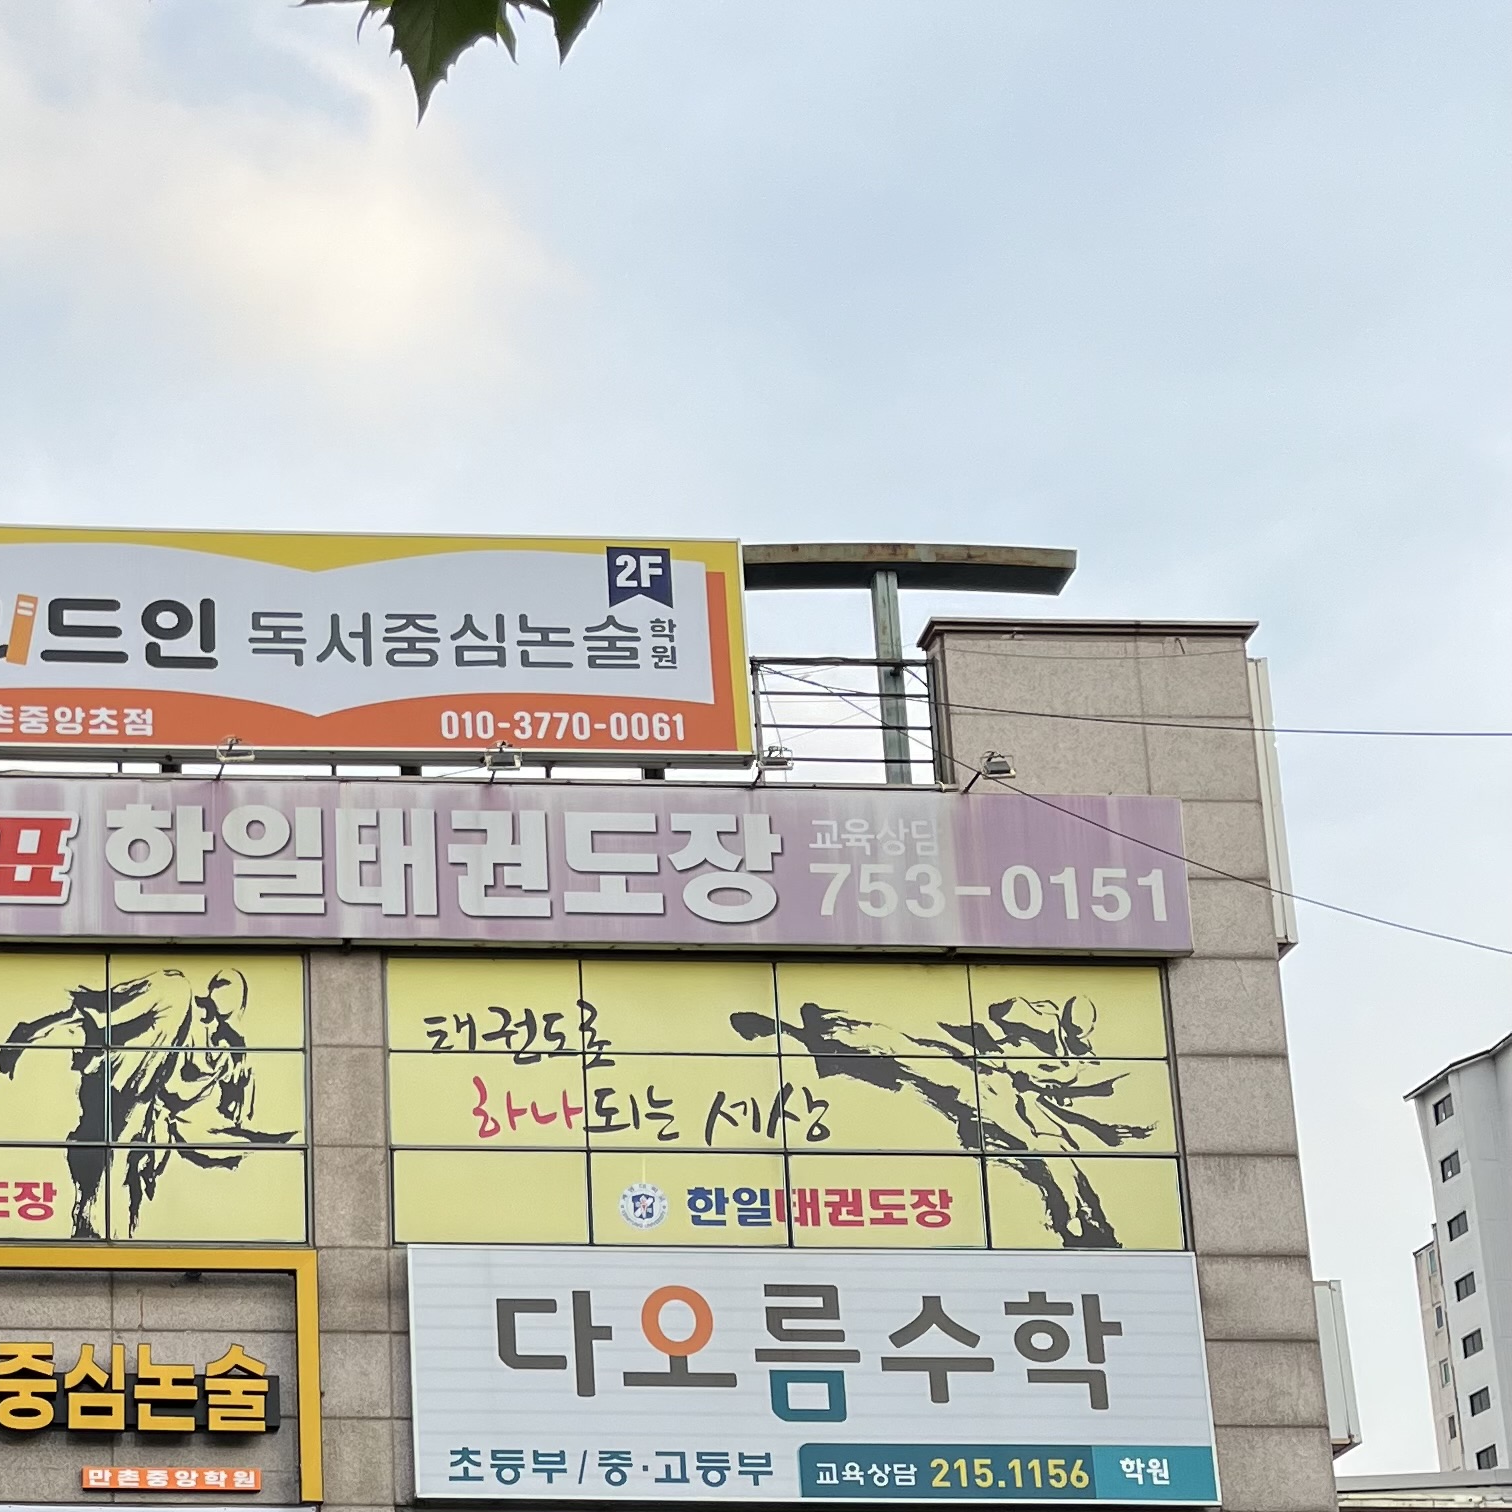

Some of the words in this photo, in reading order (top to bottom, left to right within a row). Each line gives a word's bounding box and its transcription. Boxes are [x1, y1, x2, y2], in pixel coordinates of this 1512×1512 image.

[615, 555, 663, 588] 2F
[248, 612, 641, 669] 독서중심논술
[441, 710, 685, 741] 010-3770-0061
[808, 818, 939, 857] 교육상담
[104, 804, 782, 923] 한일태권도장
[809, 863, 1169, 922] 753-0151
[424, 1000, 616, 1068] 태권도로
[472, 1077, 679, 1138] 하나되는
[705, 1084, 831, 1145] 세상
[687, 1187, 953, 1228] 한일태권도장
[496, 1285, 1123, 1422] 다오름수학
[88, 1469, 257, 1488] 만촌중앙학원
[816, 1461, 918, 1487] 교육상담
[930, 1458, 1089, 1489] 215.1156
[1119, 1457, 1170, 1486] 학원
